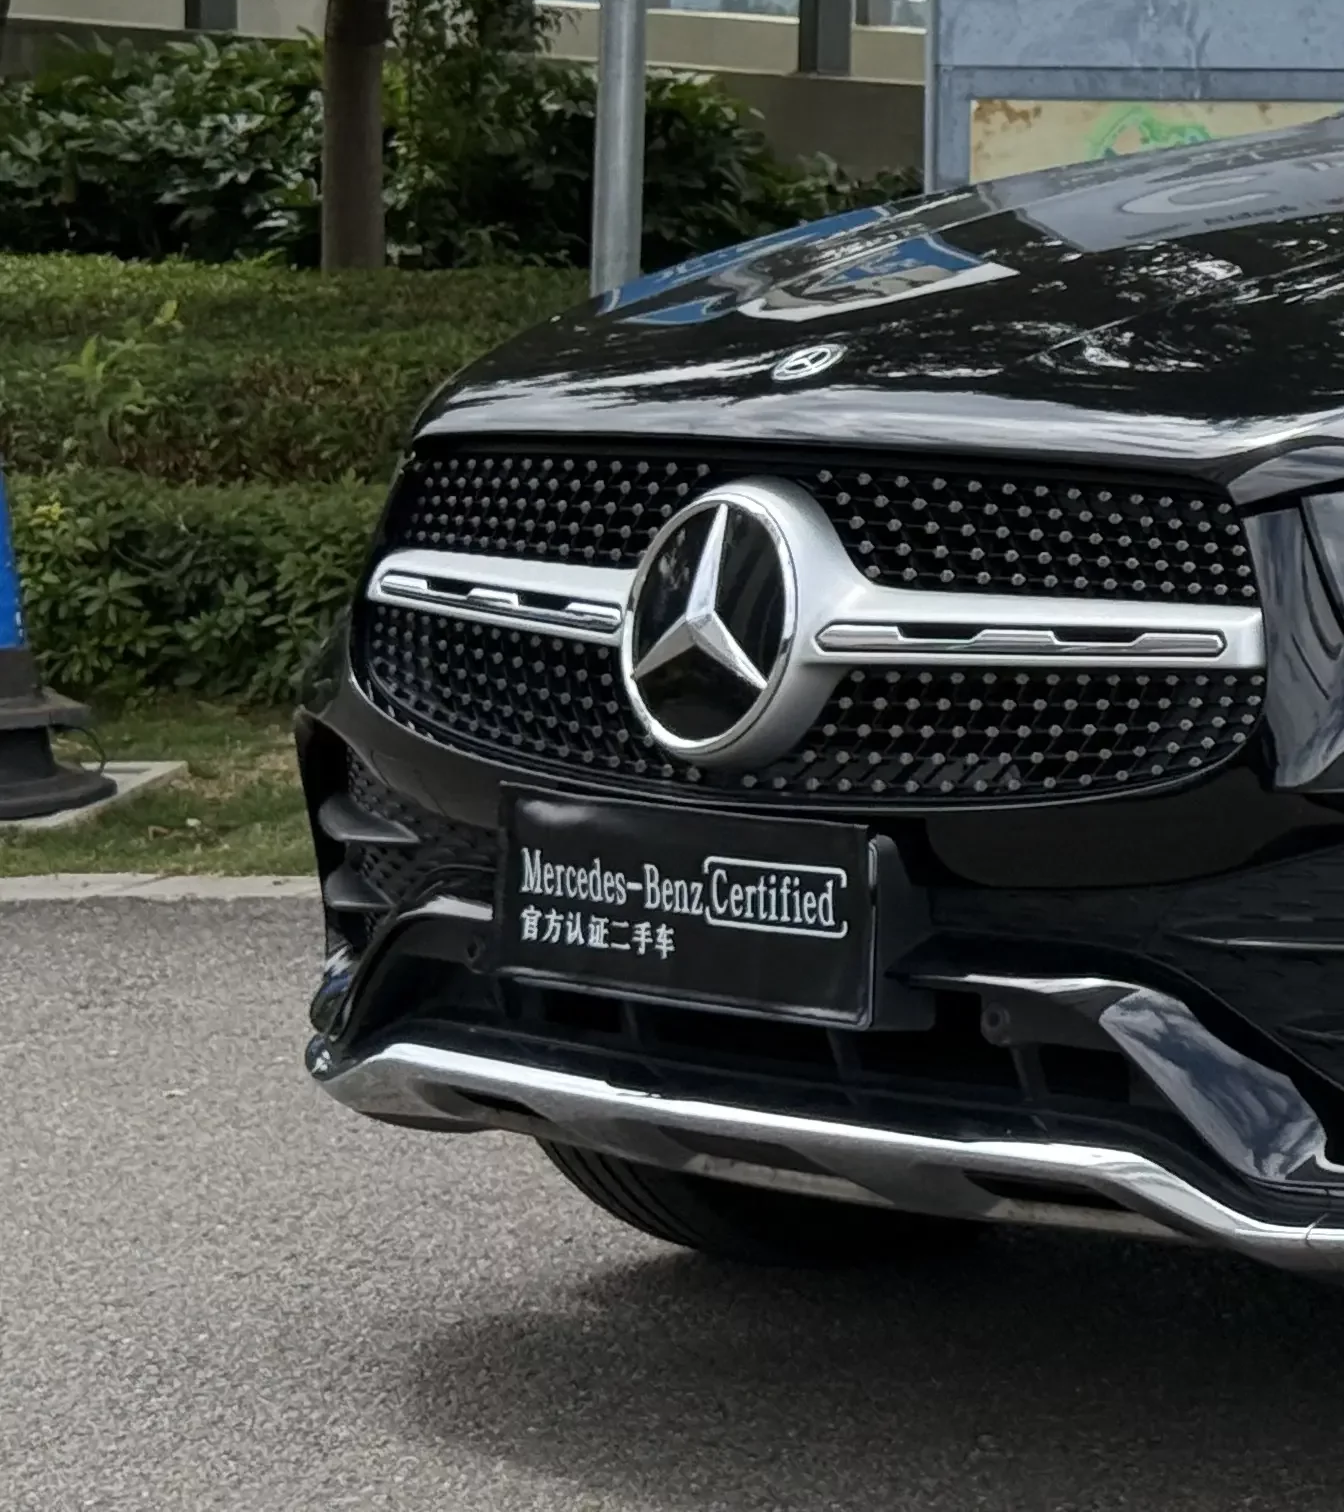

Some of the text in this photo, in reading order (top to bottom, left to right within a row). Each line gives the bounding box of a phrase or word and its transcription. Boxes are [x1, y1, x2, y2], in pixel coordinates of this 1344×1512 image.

[519, 847, 836, 928] Mercedes-Benz Certified
[519, 904, 676, 960] 官方认证二手车
